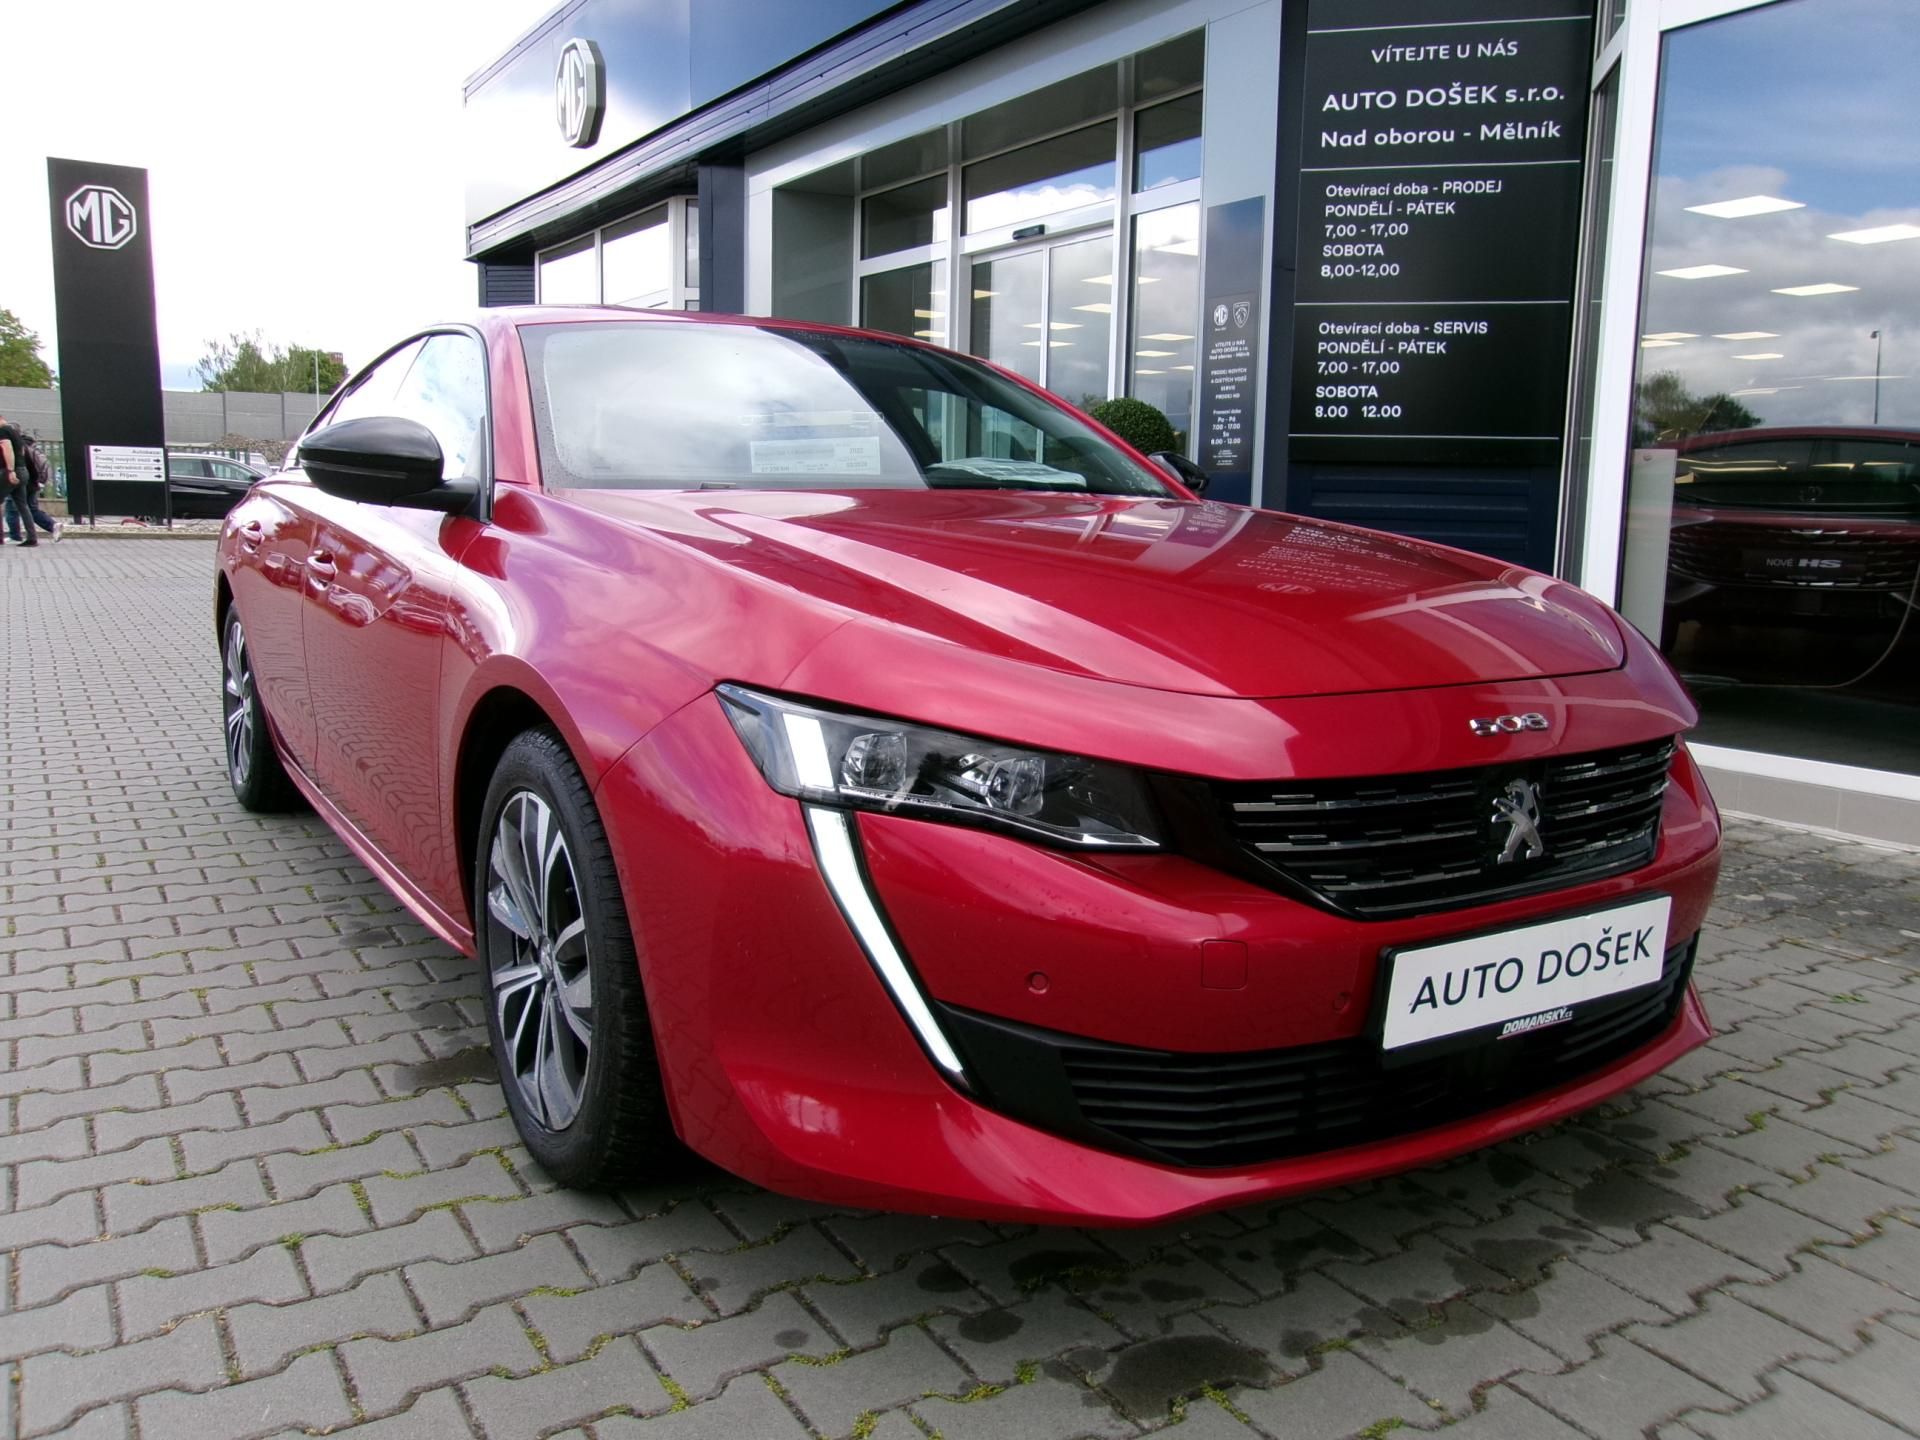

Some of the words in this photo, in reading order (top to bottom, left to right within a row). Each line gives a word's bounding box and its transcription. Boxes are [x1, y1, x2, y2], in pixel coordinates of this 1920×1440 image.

[1371, 45, 1450, 63] VÍTEJTE
[1457, 44, 1470, 58] U
[1478, 38, 1518, 57] NÁS
[1322, 90, 1397, 112] AUTO
[1405, 82, 1498, 108] DOŠEK
[1505, 86, 1565, 102] s.r.o.
[1321, 129, 1366, 148] Nad
[1374, 128, 1455, 145] oborou
[1480, 121, 1561, 141] Mělník
[1326, 183, 1390, 198] Otevírací
[1393, 182, 1428, 196] doba
[1442, 180, 1502, 194] PRODEJ
[1325, 202, 1392, 217] PONDĚLÍ
[1406, 200, 1456, 215] PÁTEK
[67, 188, 134, 247] MG
[1324, 224, 1357, 238] 7,00
[1370, 223, 1409, 237] 17,00
[1322, 244, 1384, 257] SOBOTA
[1319, 322, 1382, 336] Otevírací
[1385, 321, 1420, 335] doba
[1433, 321, 1488, 334] SERVIS
[1318, 339, 1384, 354] PONDĚLÍ
[1398, 338, 1447, 354] PÁTEK
[1317, 362, 1348, 376] 7,00
[1361, 361, 1400, 375] 17,00
[1315, 385, 1378, 398] SOBOTA
[1315, 405, 1348, 418] 8.00
[1361, 405, 1402, 418] 12.00
[1798, 558, 1842, 568] HS
[1469, 712, 1549, 737] 508
[1409, 957, 1524, 1015] AUTO
[1536, 925, 1654, 986] DOŠEK
